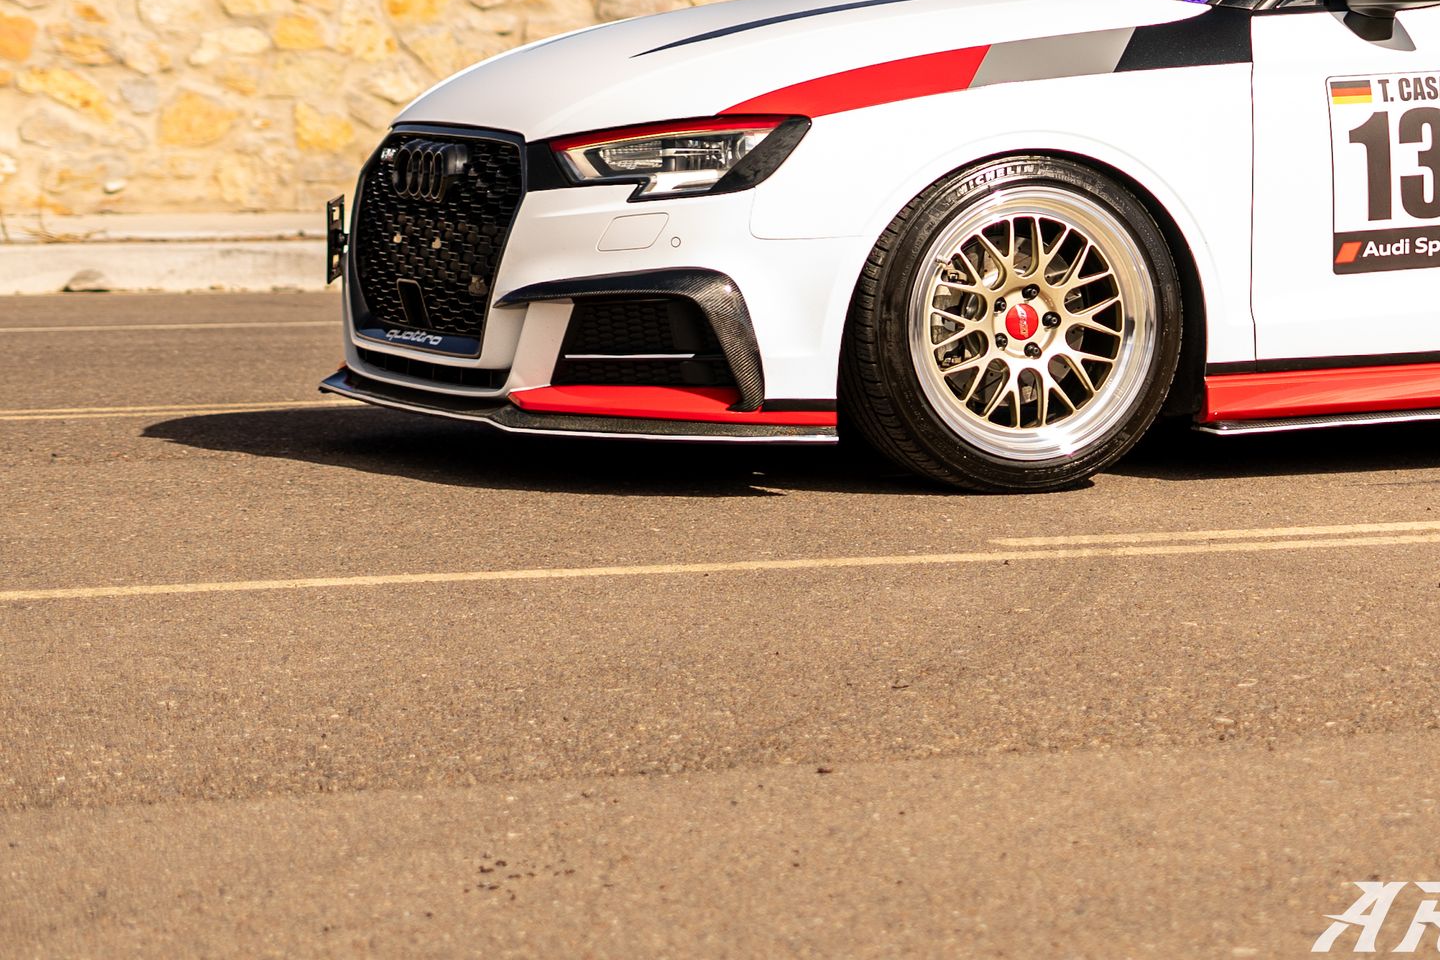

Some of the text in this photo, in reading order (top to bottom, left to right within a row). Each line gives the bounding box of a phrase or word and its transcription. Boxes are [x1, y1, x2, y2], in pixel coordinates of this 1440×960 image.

[1377, 79, 1394, 102] T.
[955, 163, 1036, 197] MICHELIN
[1361, 238, 1410, 258] Audi
[385, 329, 443, 346] quattro
